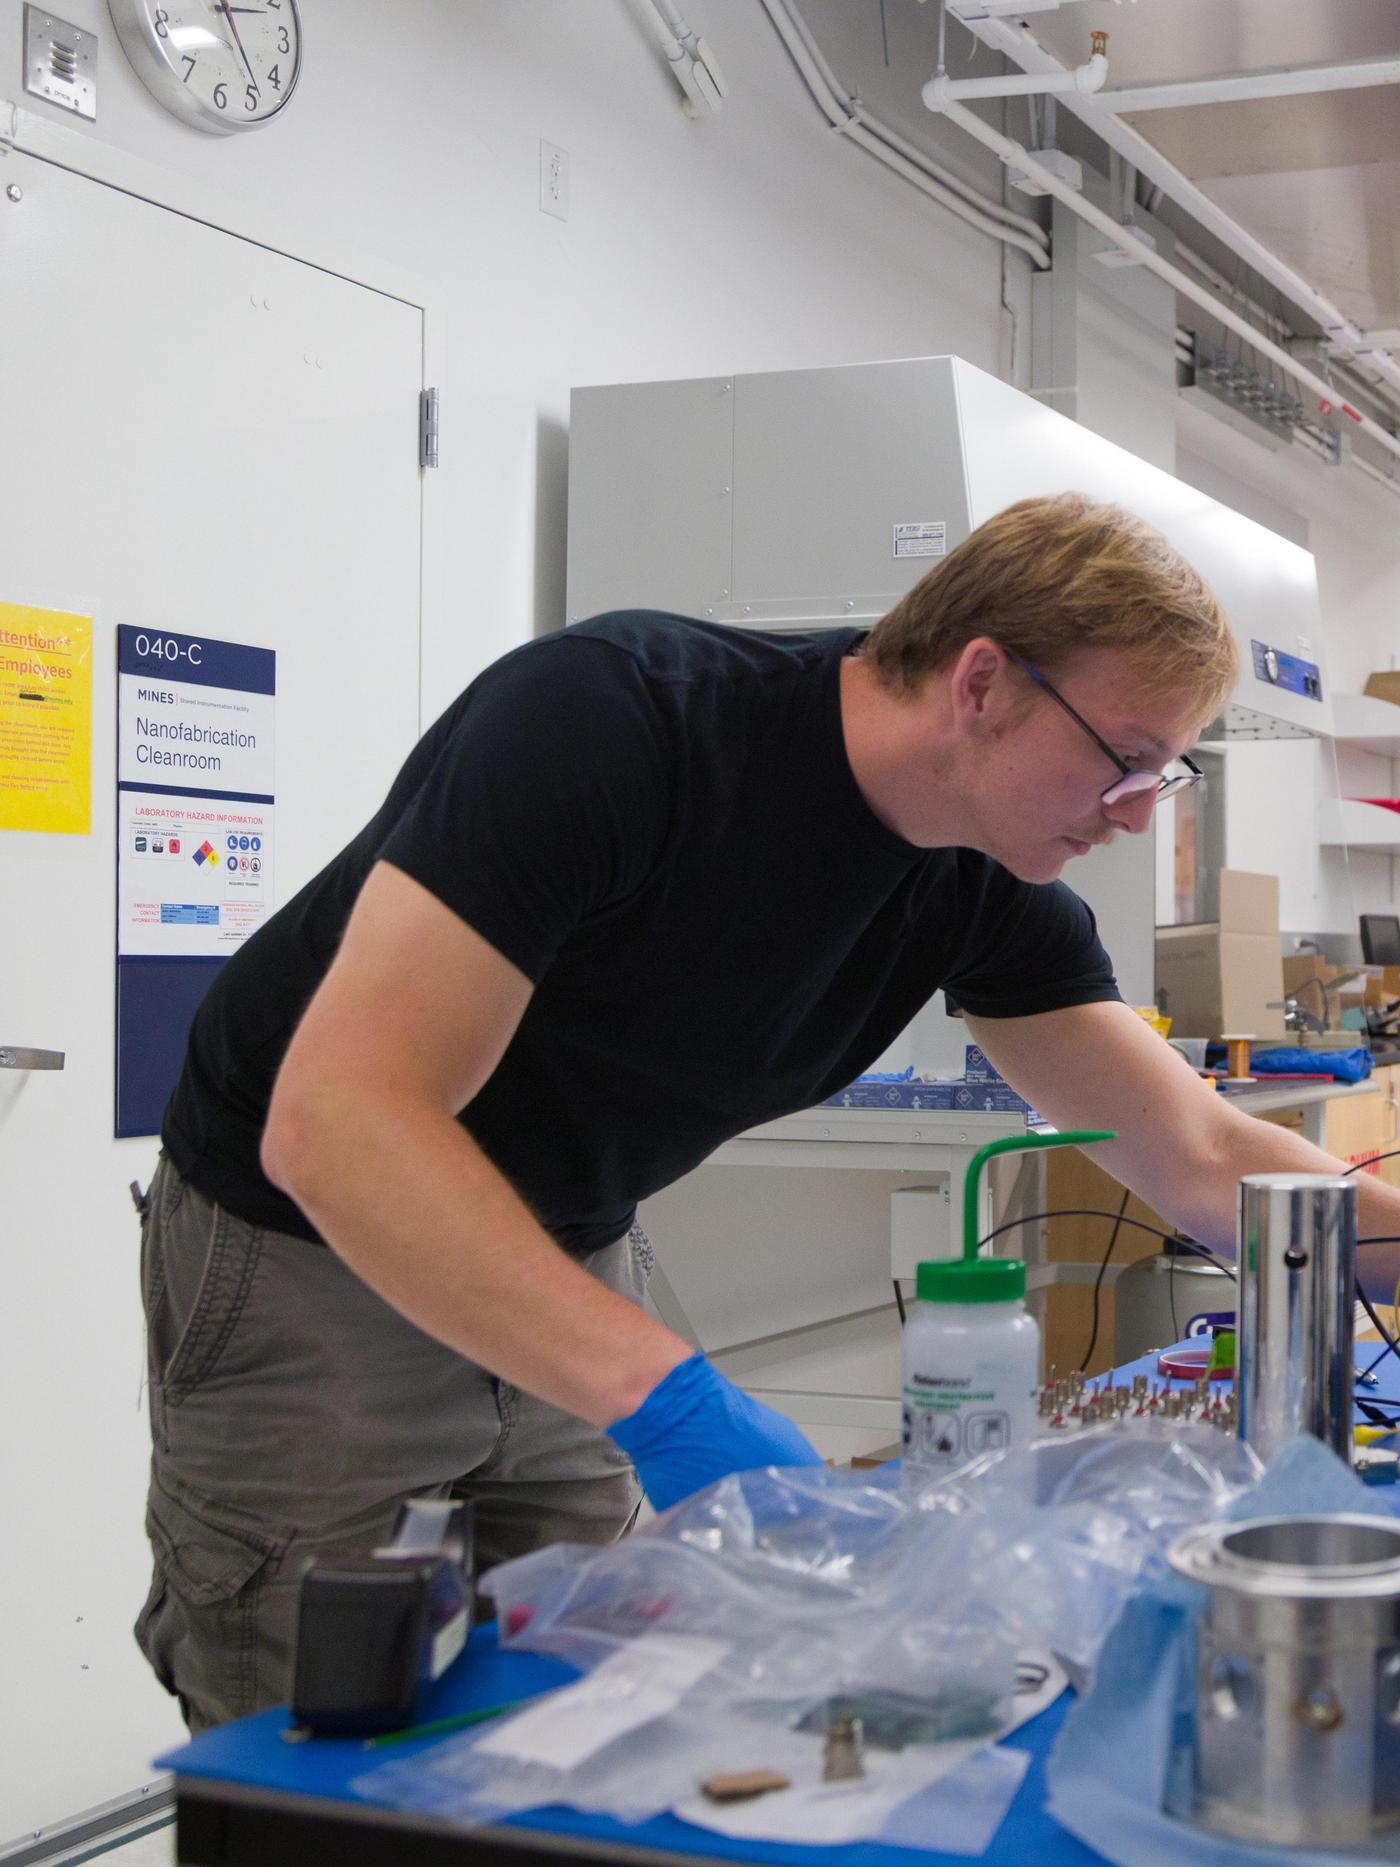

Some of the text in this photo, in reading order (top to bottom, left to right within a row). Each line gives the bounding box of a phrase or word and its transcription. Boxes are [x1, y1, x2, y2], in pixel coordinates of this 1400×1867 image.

[155, 9, 169, 38] 8
[277, 26, 290, 54] 3
[181, 55, 196, 83] 7
[267, 64, 281, 91] 4
[213, 83, 227, 109] 6
[244, 84, 258, 111] 5
[135, 634, 202, 665] 040-C
[138, 688, 175, 704] MINES
[136, 717, 256, 749] Nanofabrication
[136, 744, 221, 770] Cleanroom
[135, 807, 263, 825] LABORATORY HAZARD INFORMATION
